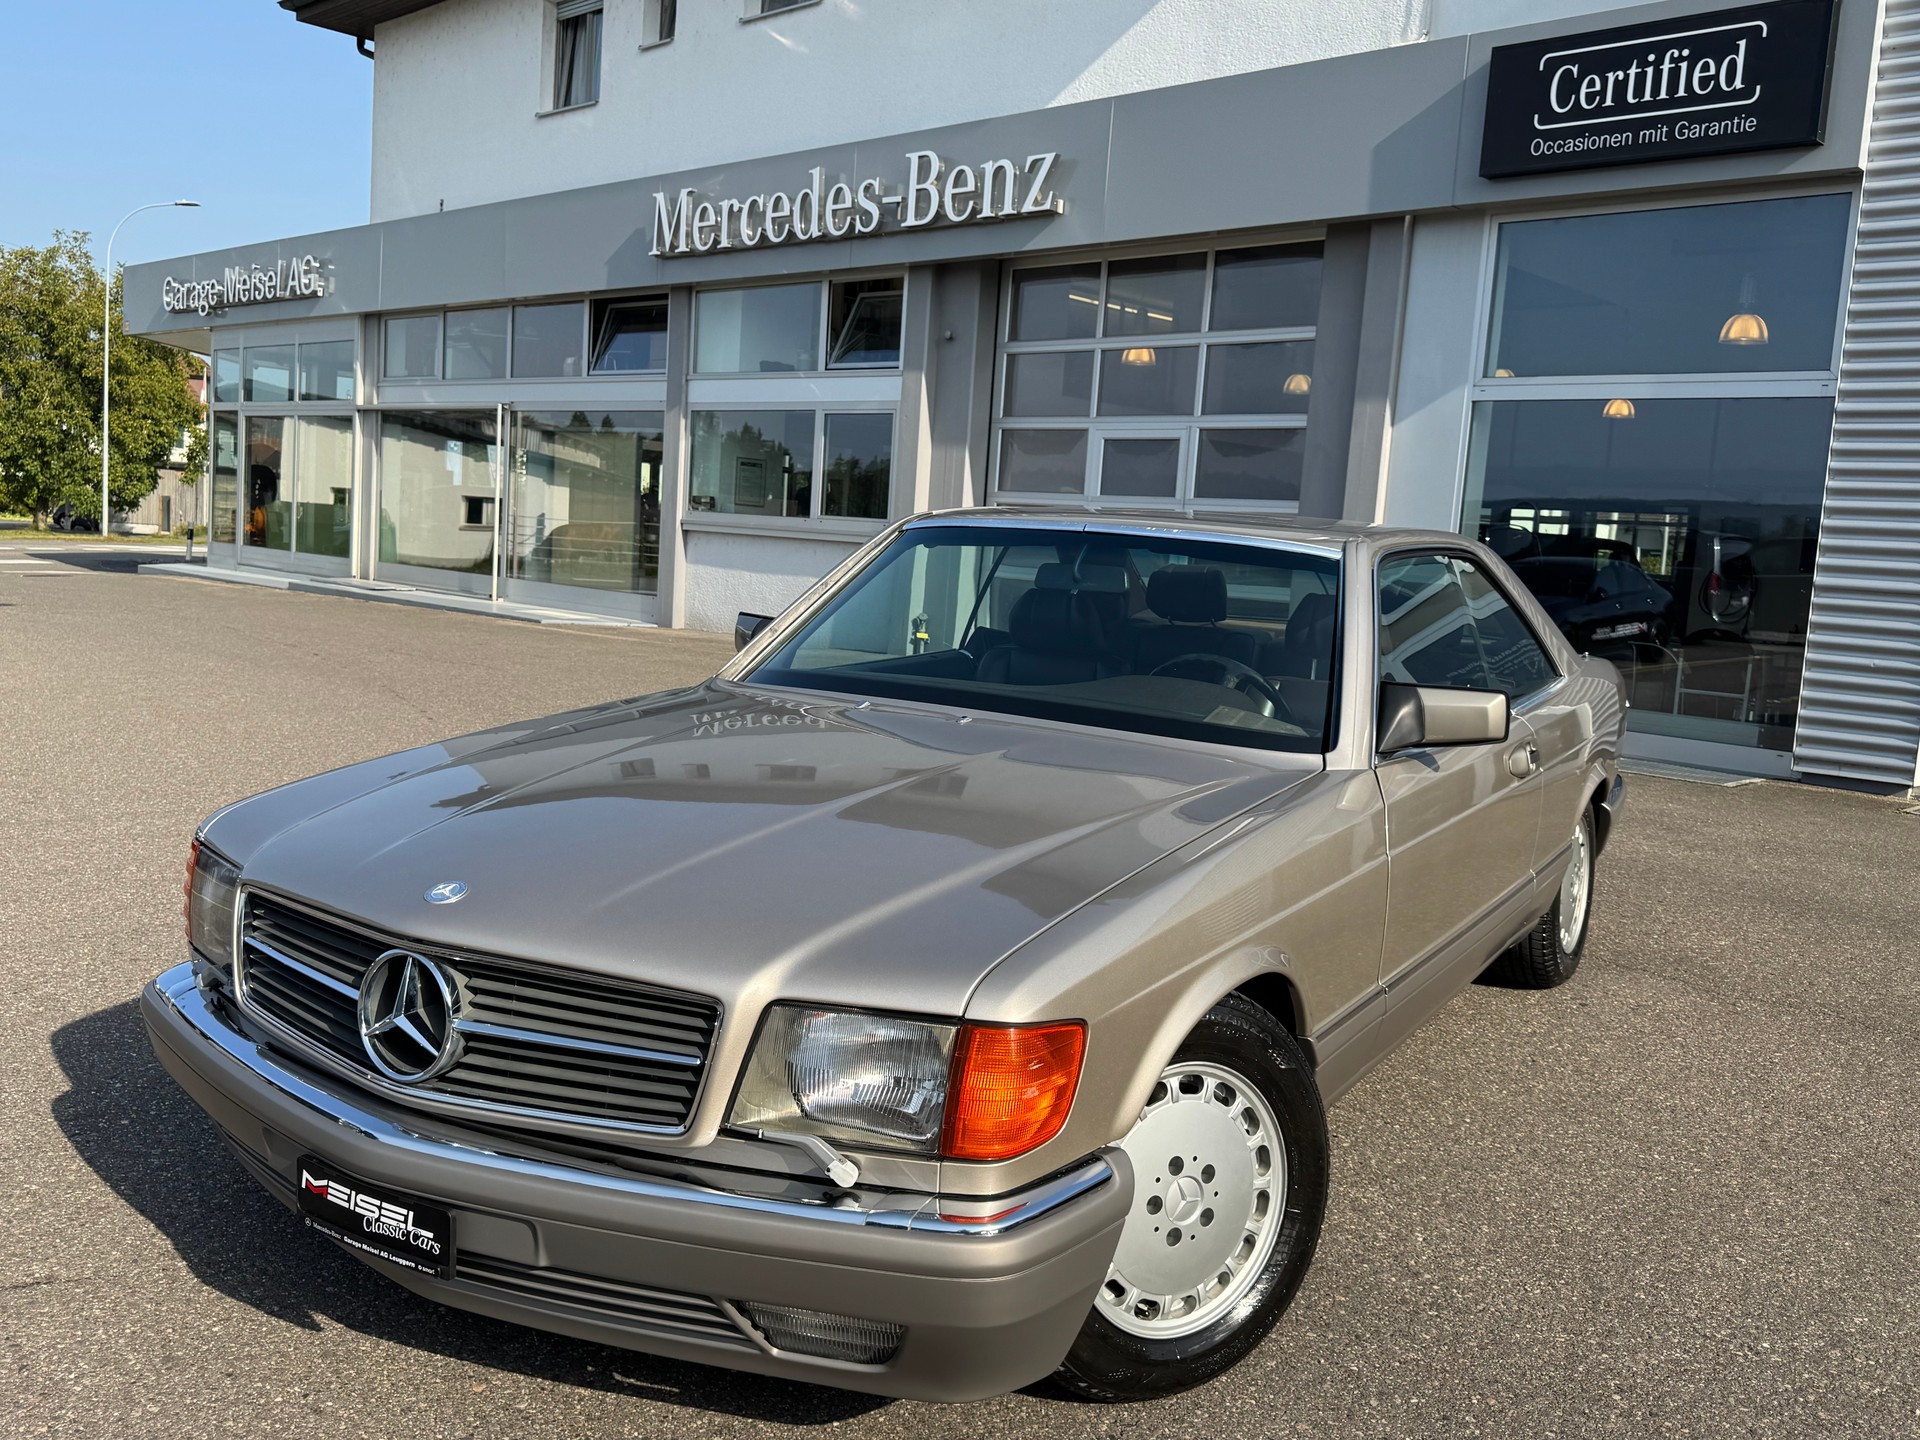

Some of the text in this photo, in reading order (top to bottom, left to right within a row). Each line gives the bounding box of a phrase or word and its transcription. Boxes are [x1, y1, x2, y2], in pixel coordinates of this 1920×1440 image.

[1550, 38, 1747, 113] Certified
[1530, 113, 1757, 156] Occasionen mit Garantie
[648, 150, 1062, 257] Mercedes-Benz
[162, 254, 319, 316] Garage Meisel AG
[301, 1168, 434, 1239] MEISEL
[343, 1235, 361, 1248] Garage
[380, 1250, 389, 1259] AG
[363, 1215, 441, 1255] Classic Cars
